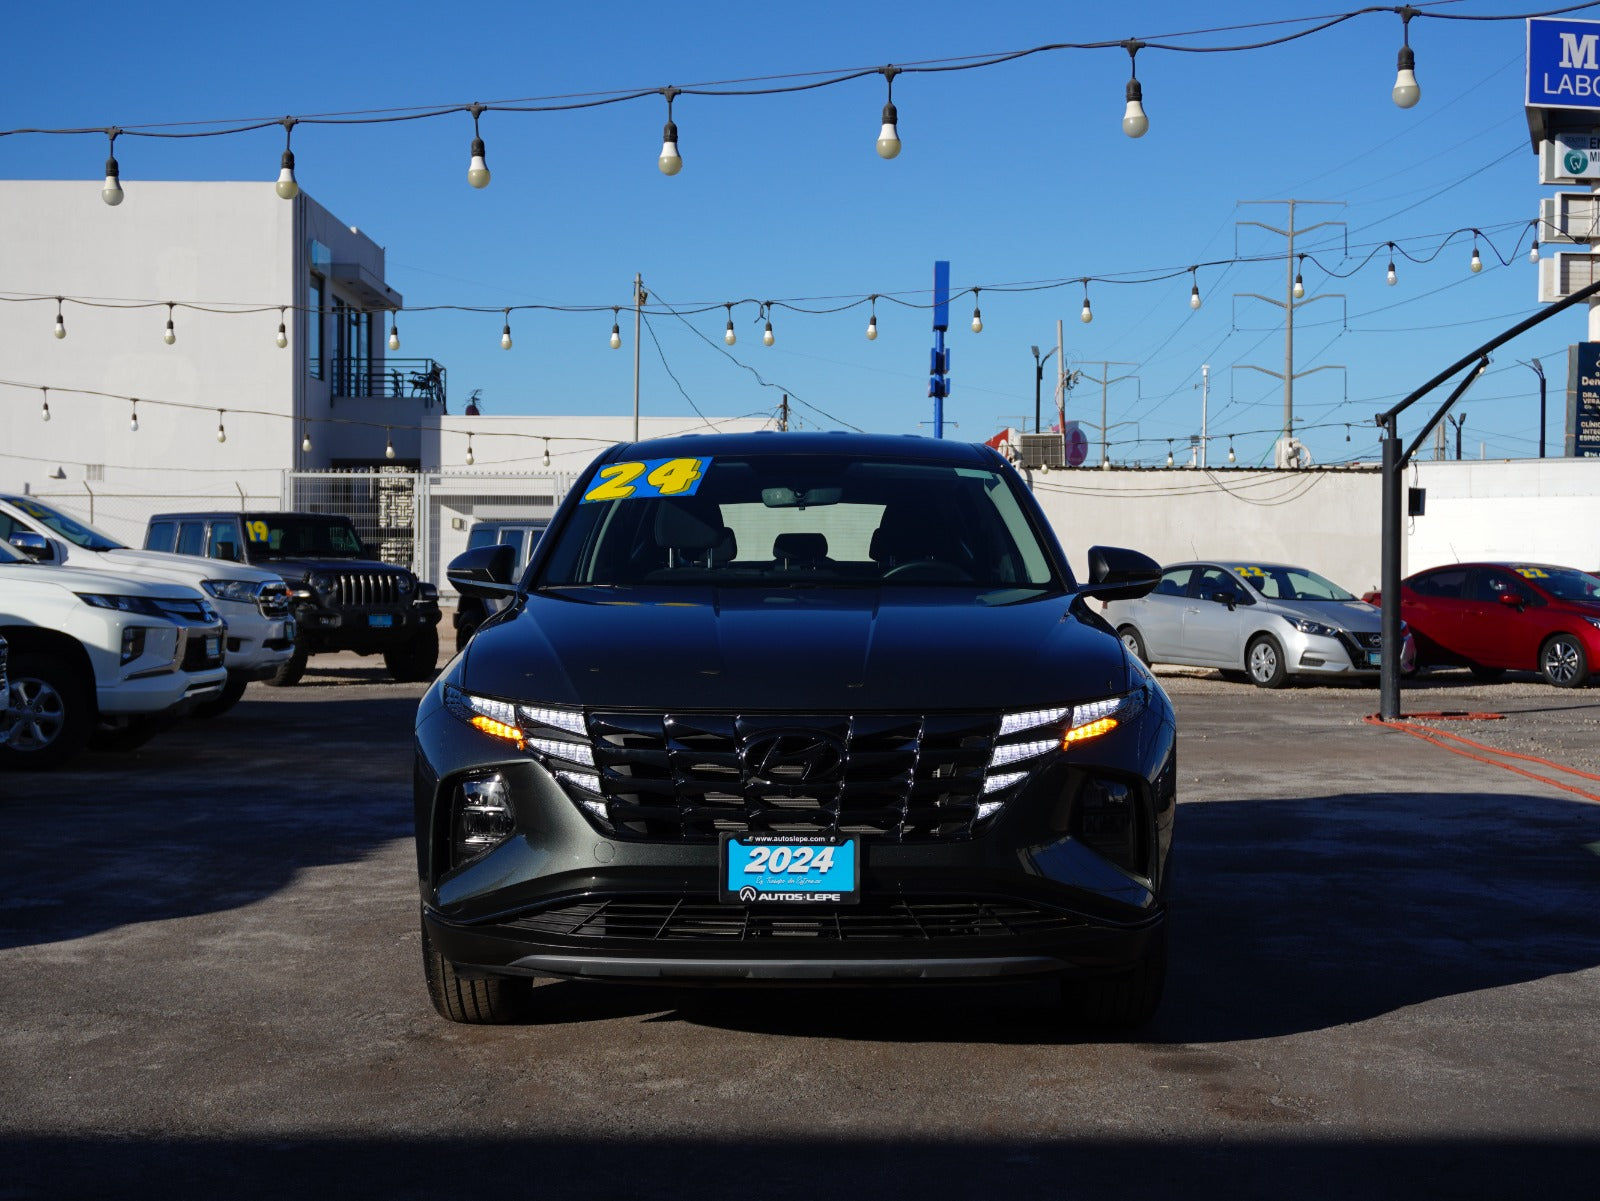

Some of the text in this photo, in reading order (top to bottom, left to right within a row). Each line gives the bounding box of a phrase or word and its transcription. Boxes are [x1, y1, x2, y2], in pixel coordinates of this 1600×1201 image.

[584, 457, 702, 501] 24
[245, 520, 268, 542] 19
[1233, 566, 1267, 577] 22
[1514, 567, 1550, 578] 22
[754, 835, 826, 843] www.autoslepe.com
[743, 846, 835, 873] 2024
